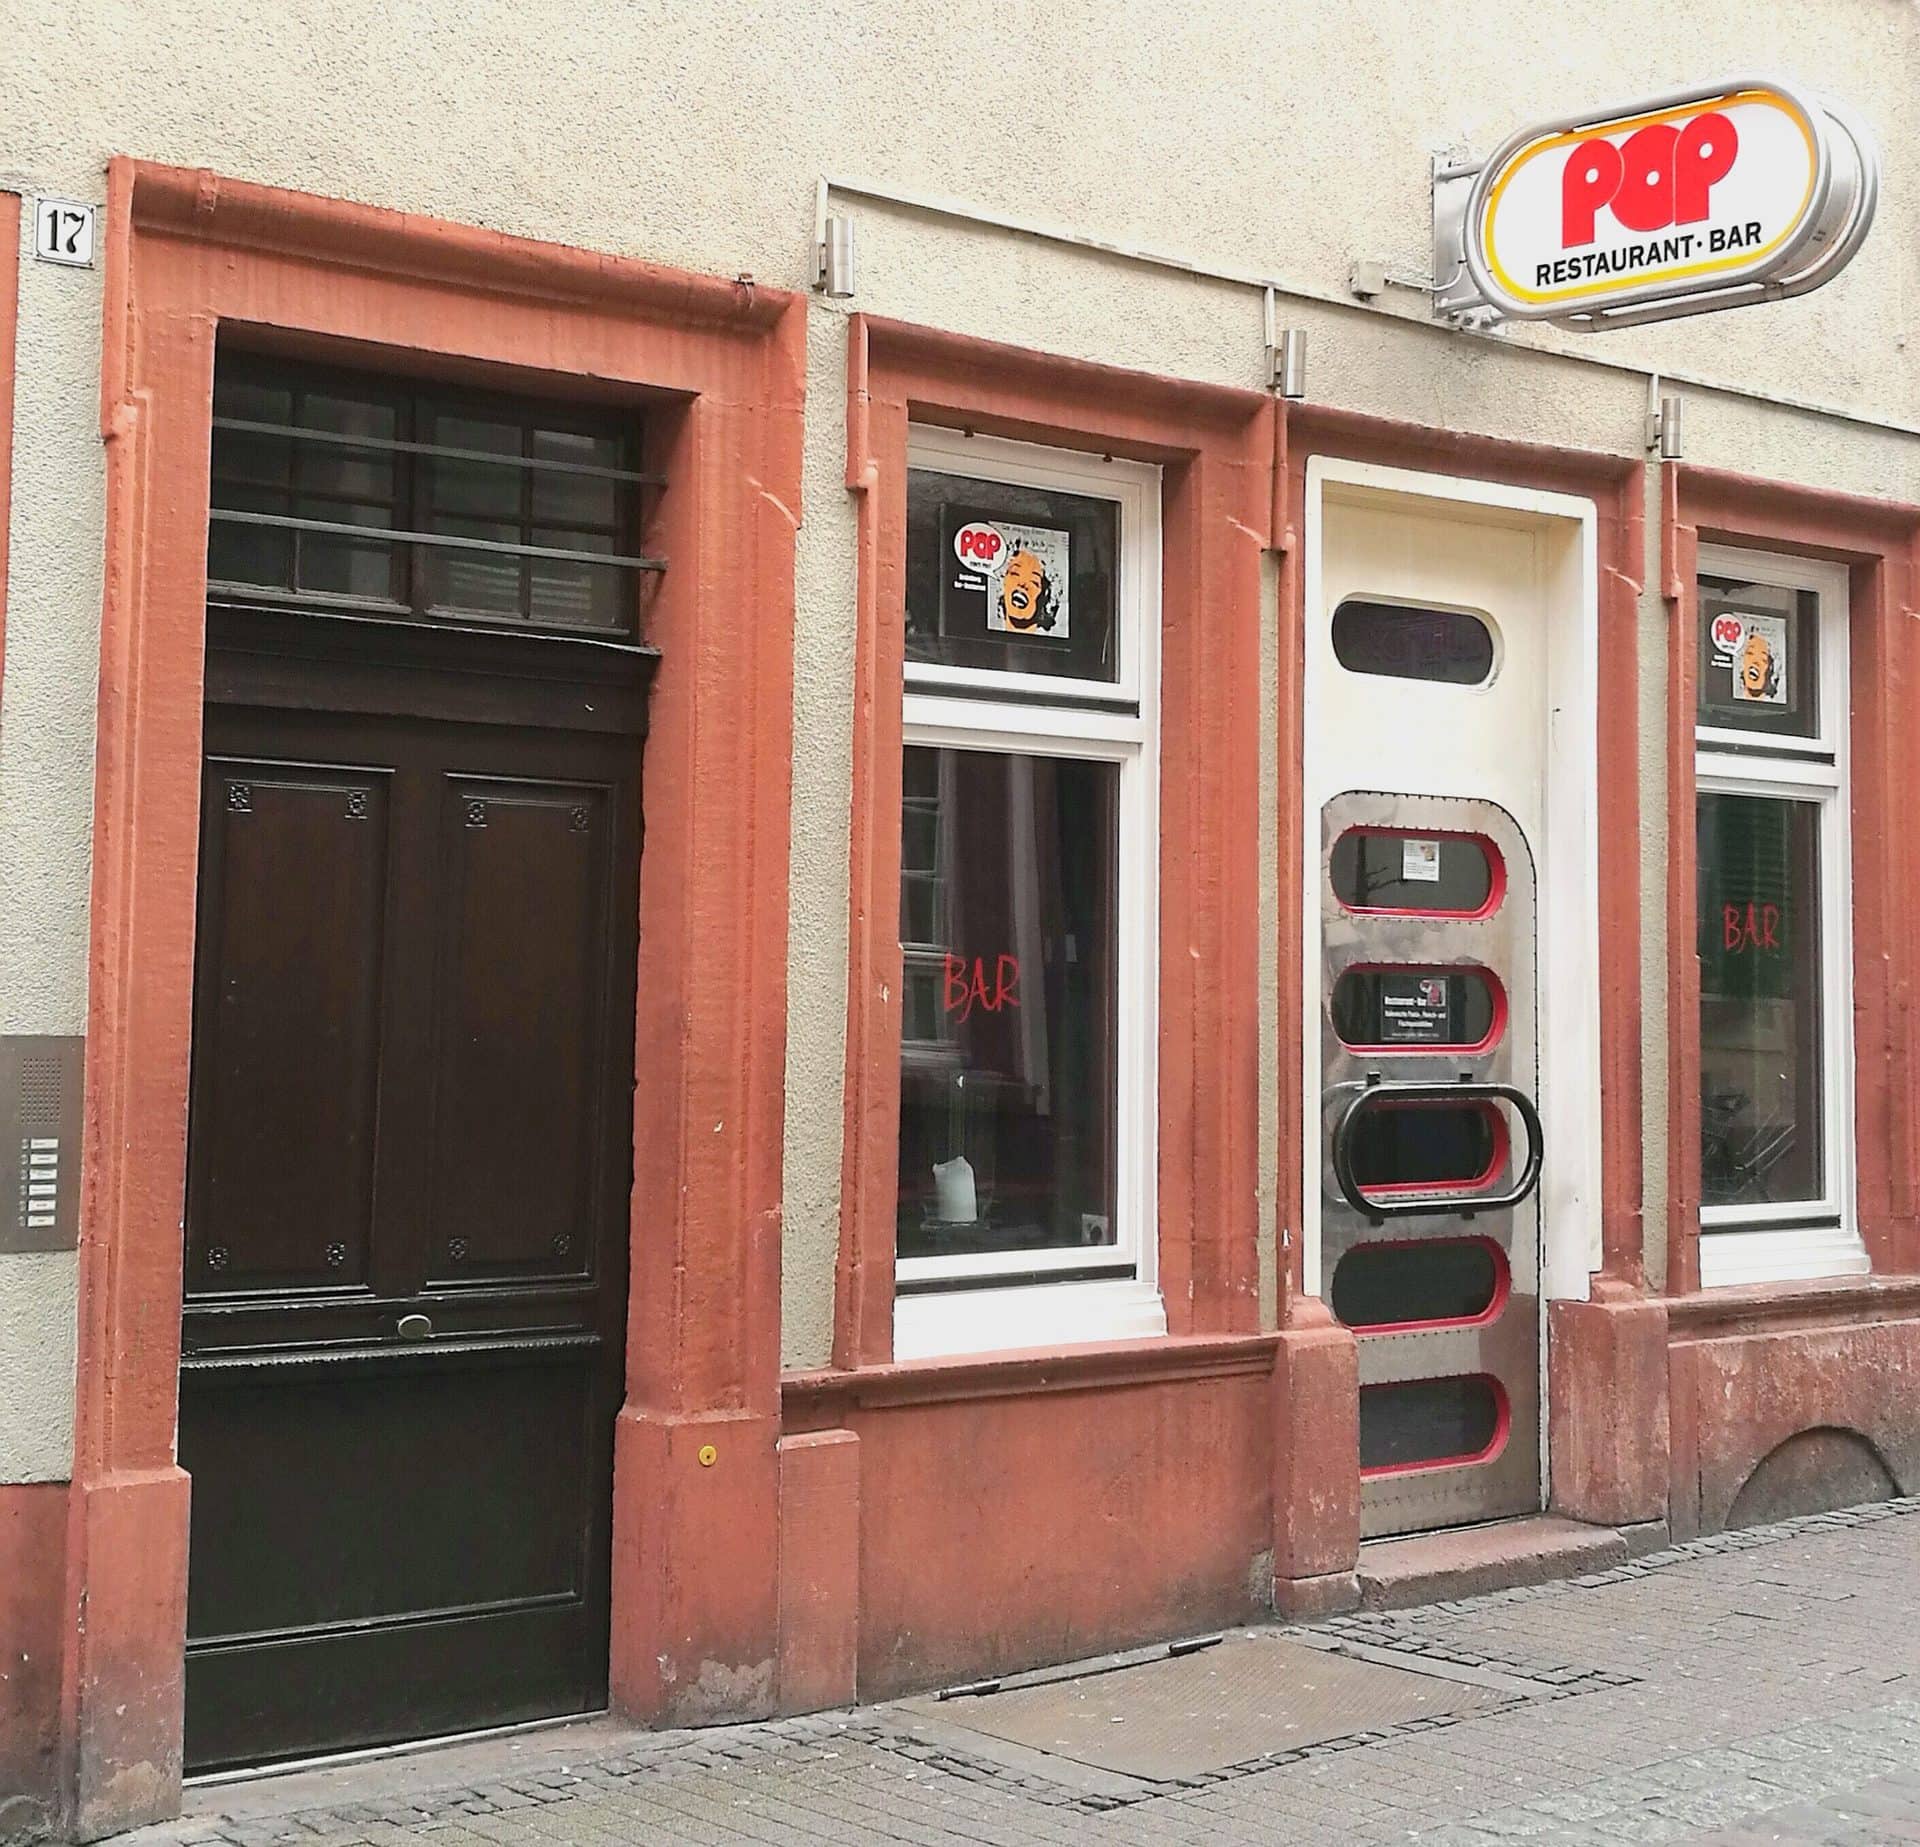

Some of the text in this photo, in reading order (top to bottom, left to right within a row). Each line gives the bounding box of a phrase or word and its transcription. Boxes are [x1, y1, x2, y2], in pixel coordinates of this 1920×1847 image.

[1561, 112, 1739, 250] POP
[46, 208, 86, 254] 17
[1535, 234, 1695, 287] RESTAURANT
[1708, 221, 1763, 254] BAR
[960, 529, 1002, 561] POP
[1715, 619, 1742, 644] POP
[1723, 901, 1781, 953] BAR
[943, 949, 1021, 1024] BAR
